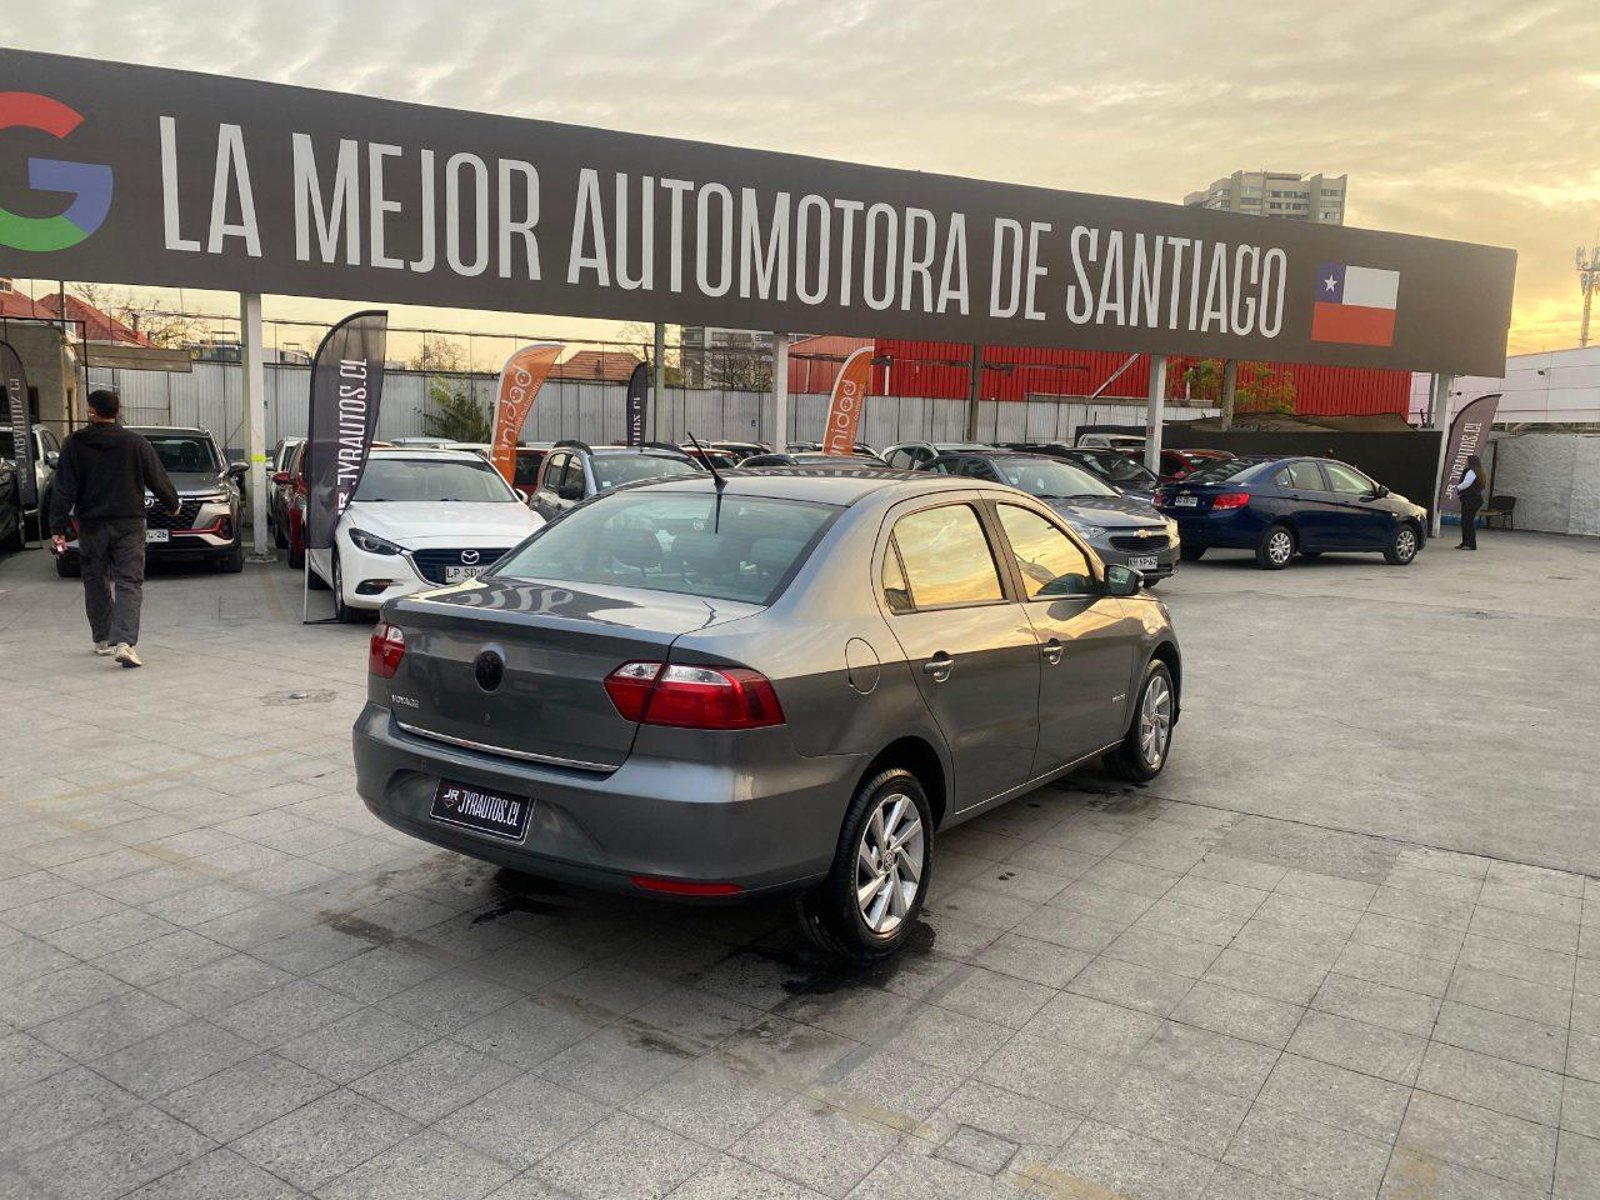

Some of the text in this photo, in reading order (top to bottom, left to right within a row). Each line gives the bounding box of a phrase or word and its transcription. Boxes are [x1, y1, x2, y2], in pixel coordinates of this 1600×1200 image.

[159, 115, 1287, 338] LA MEJOR AUTOMOTORA DE SANTIAGO
[337, 358, 368, 486] JYRAUTOS.CL
[443, 788, 521, 827] JR JYRAUTOS.CL
